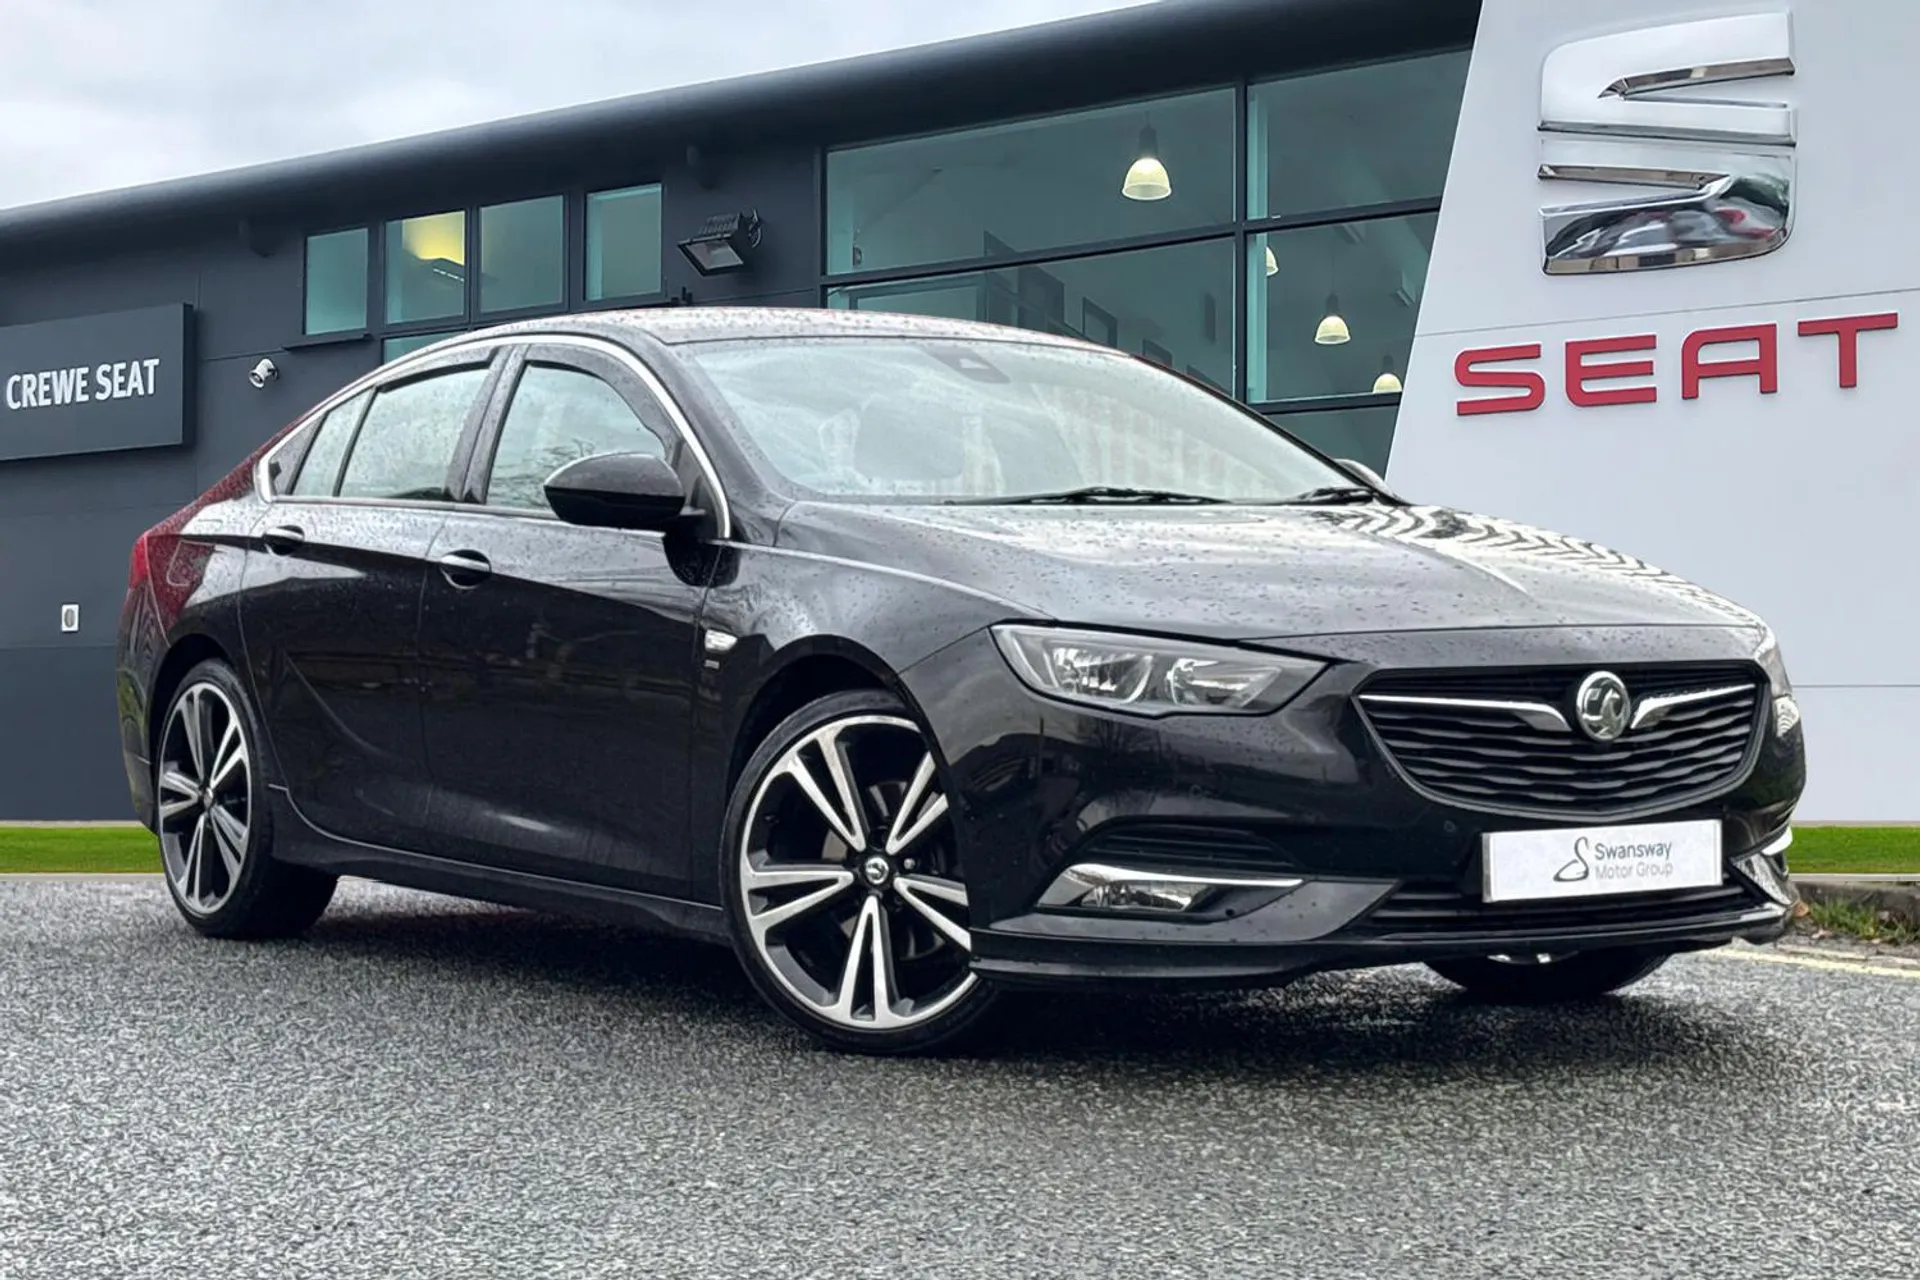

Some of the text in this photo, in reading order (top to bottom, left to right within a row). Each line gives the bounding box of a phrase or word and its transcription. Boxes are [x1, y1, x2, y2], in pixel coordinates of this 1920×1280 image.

[1454, 312, 1898, 416] SEAT
[6, 358, 160, 410] CREWE SEAT
[1594, 842, 1672, 861] Swansway
[1595, 861, 1673, 879] Motor Group
